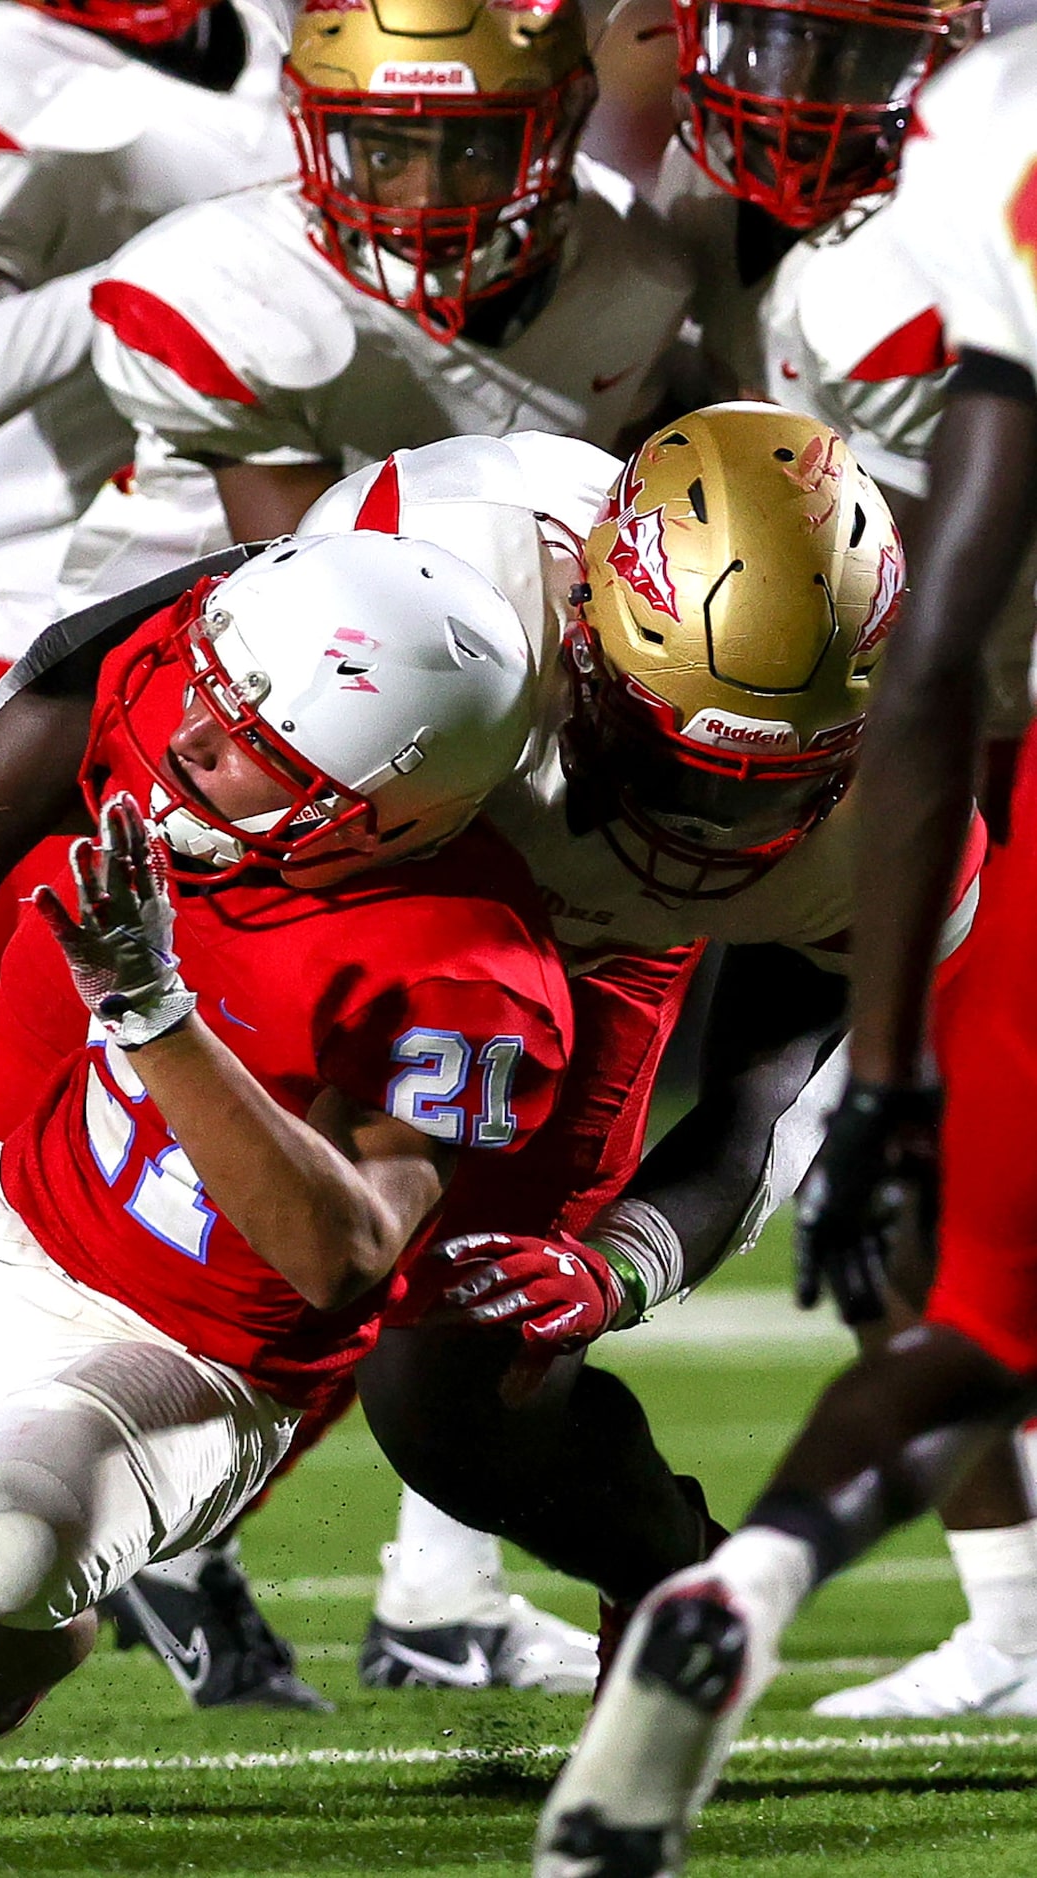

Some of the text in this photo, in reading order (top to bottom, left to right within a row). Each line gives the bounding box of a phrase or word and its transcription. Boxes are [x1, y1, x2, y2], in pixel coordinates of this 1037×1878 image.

[384, 68, 462, 84] Riddell
[703, 719, 789, 745] Riddell
[385, 1026, 524, 1147] 21
